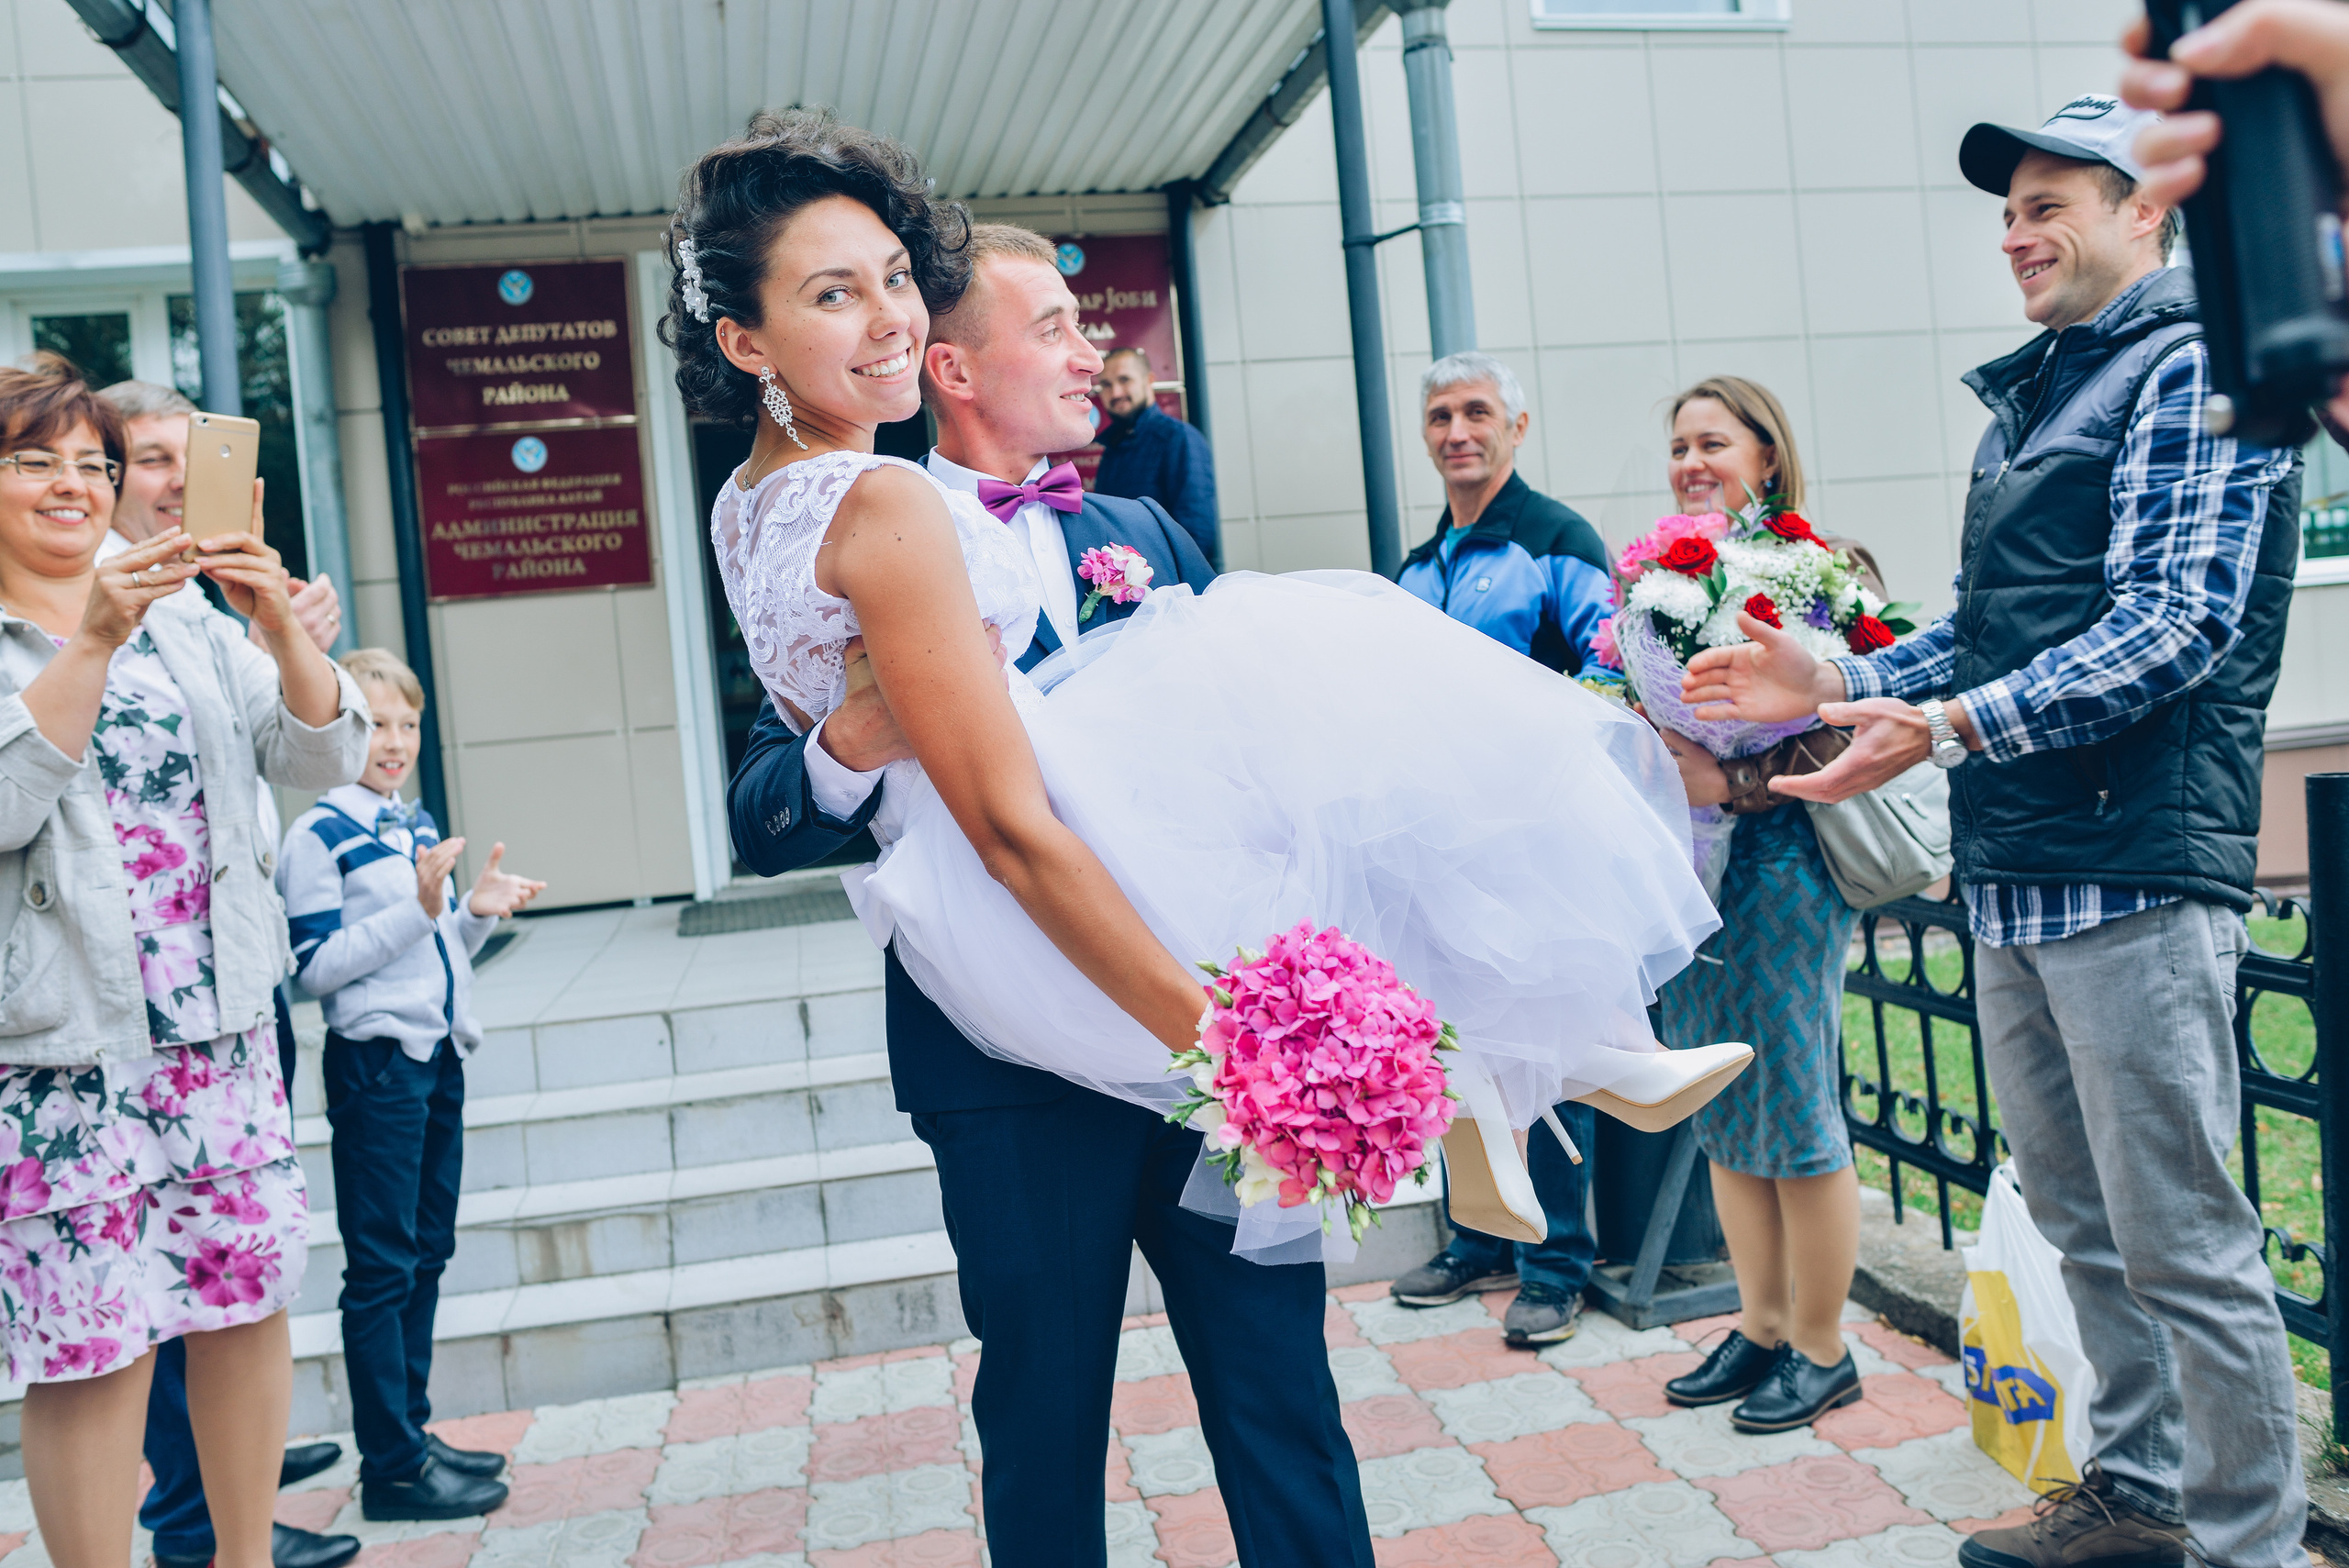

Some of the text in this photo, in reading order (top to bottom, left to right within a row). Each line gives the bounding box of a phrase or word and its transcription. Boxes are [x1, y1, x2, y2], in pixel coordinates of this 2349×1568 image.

[422, 319, 618, 347] СОВЕТ ДЕПУТАТОВ
[446, 350, 601, 376] ЧЕМАЛЬСКОГО
[482, 382, 570, 406] РАЙОНА
[431, 508, 639, 540] АДМИНИСТРАЦИЯ
[452, 532, 623, 561] ЧЕМАЛЬСКОГО
[492, 556, 587, 580] РАЙОНА
